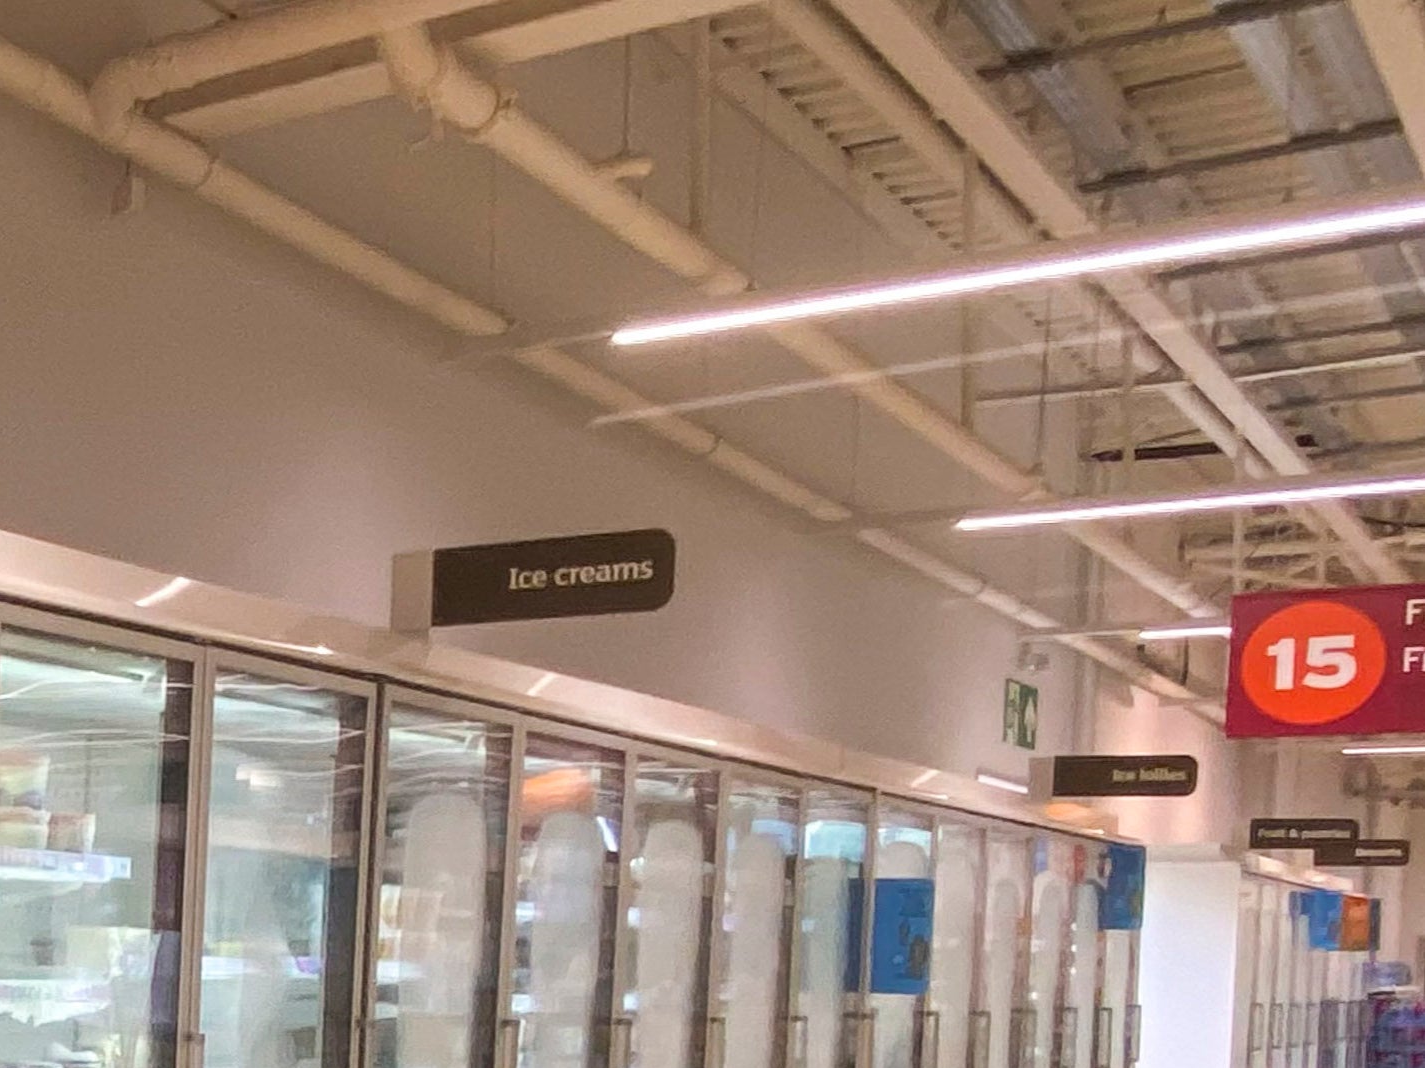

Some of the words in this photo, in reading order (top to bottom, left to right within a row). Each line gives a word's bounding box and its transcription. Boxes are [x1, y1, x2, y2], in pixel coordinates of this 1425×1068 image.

[508, 567, 547, 590] Ice
[553, 559, 654, 586] creams
[1266, 634, 1357, 691] 15
